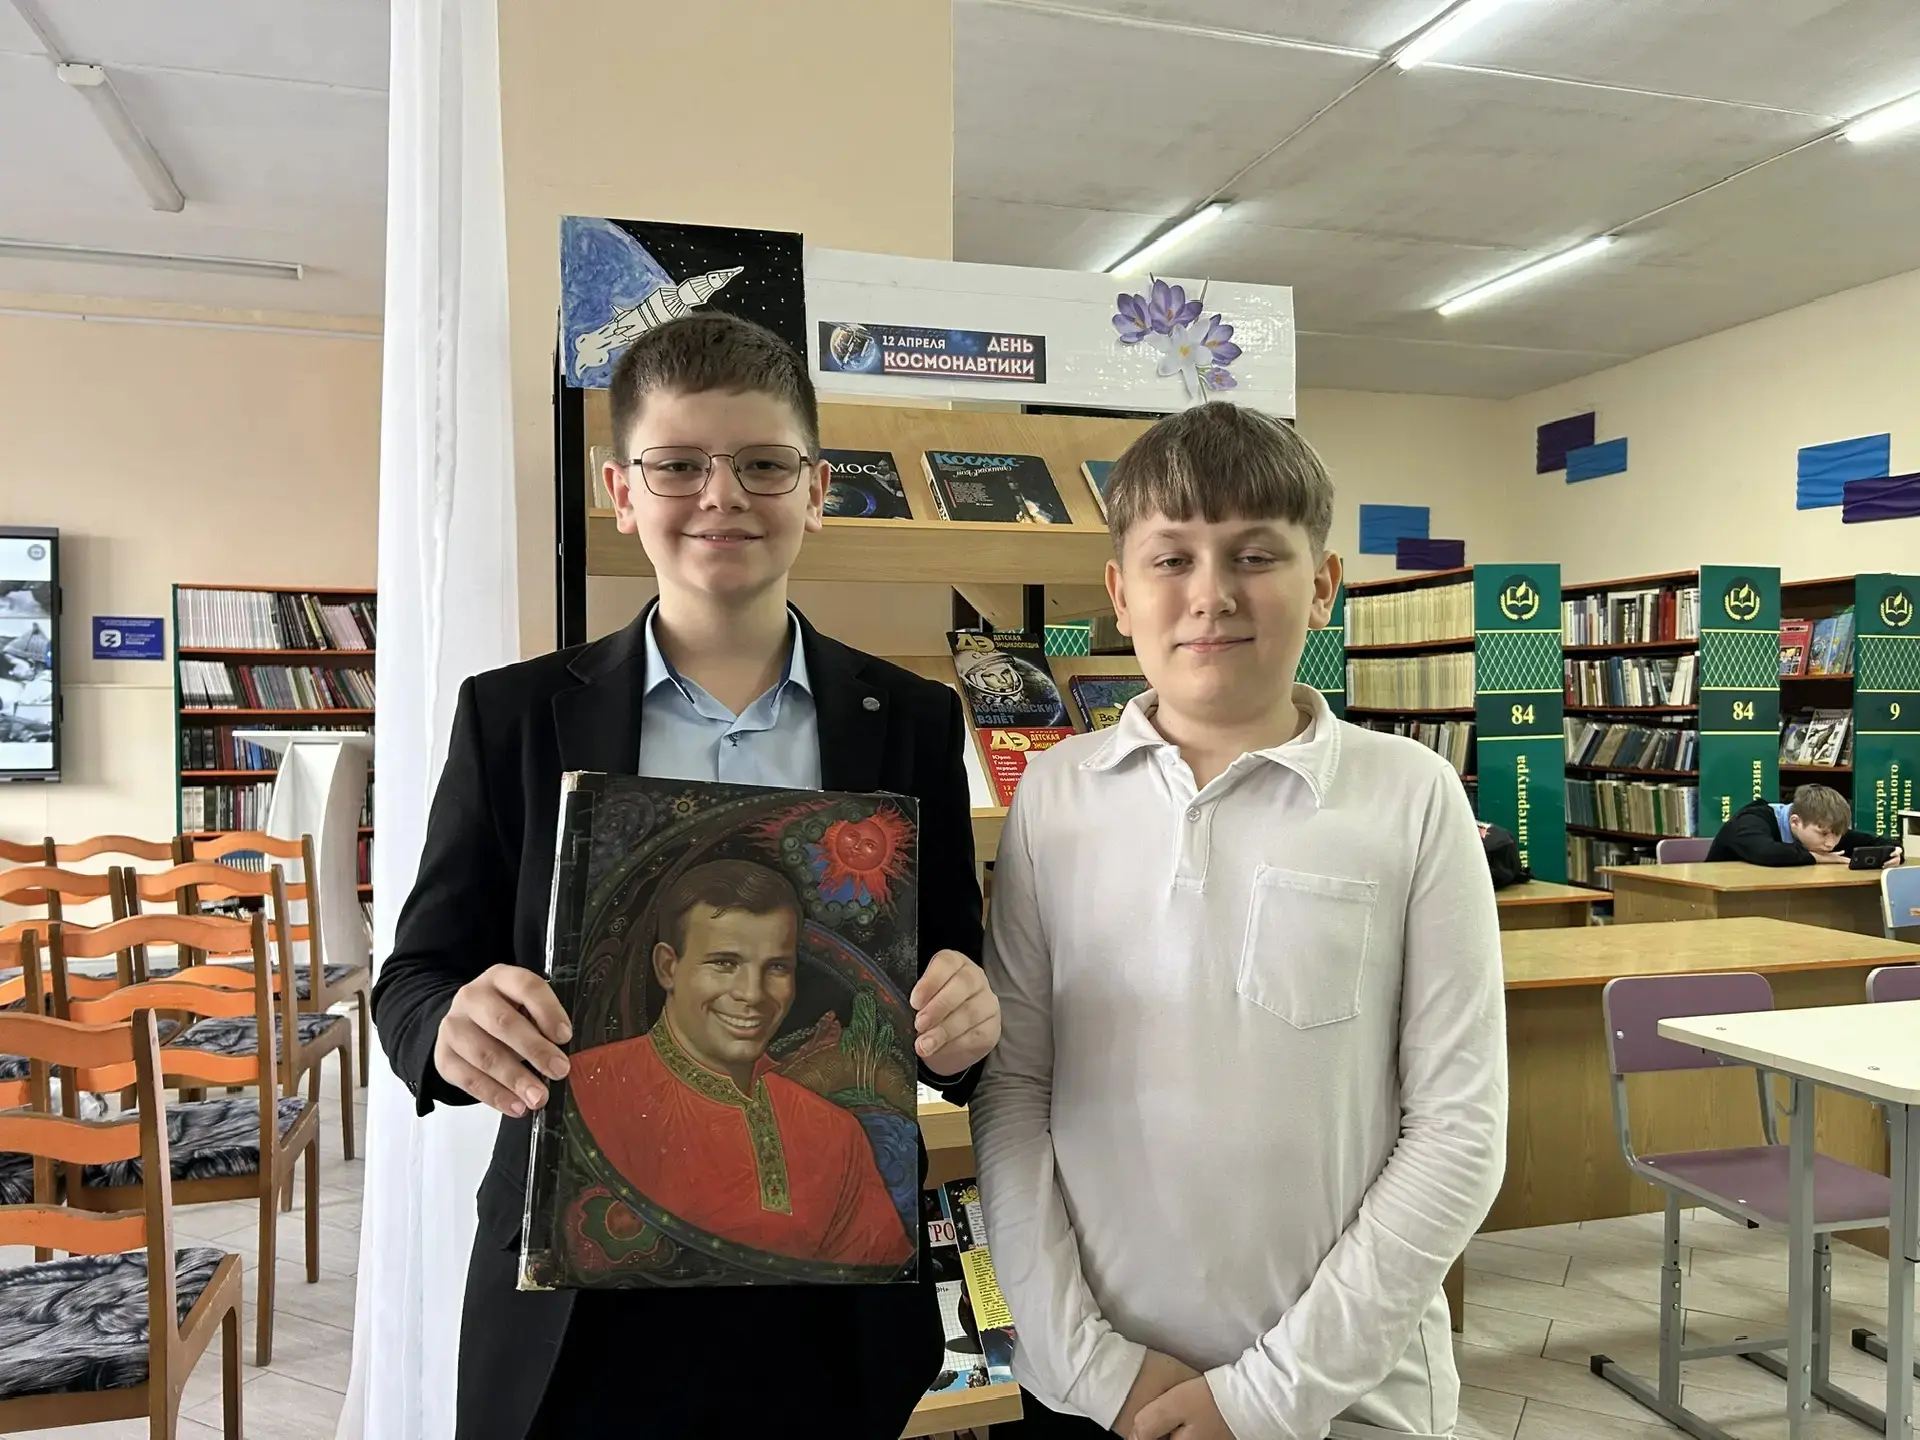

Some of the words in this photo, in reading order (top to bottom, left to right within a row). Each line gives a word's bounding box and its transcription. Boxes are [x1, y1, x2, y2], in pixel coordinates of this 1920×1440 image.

[882, 335, 895, 347] 12
[897, 336, 946, 350] АПРЕЛЯ
[987, 336, 1034, 353] ДЕНЬ
[883, 352, 1035, 375] КОСМОНАВТИКИ
[829, 463, 878, 475] МОС
[973, 702, 1062, 713] КОСМИЧЕСКИЙ
[1511, 704, 1535, 725] 84
[1733, 701, 1754, 720] 84
[1890, 702, 1900, 721] 9
[976, 712, 1015, 724] ВЗЛЁТ
[1030, 733, 1060, 741] ДЕТСКАЯ
[1516, 755, 1530, 845] литература
[1876, 780, 1887, 837] ература
[1890, 764, 1900, 838] рсального
